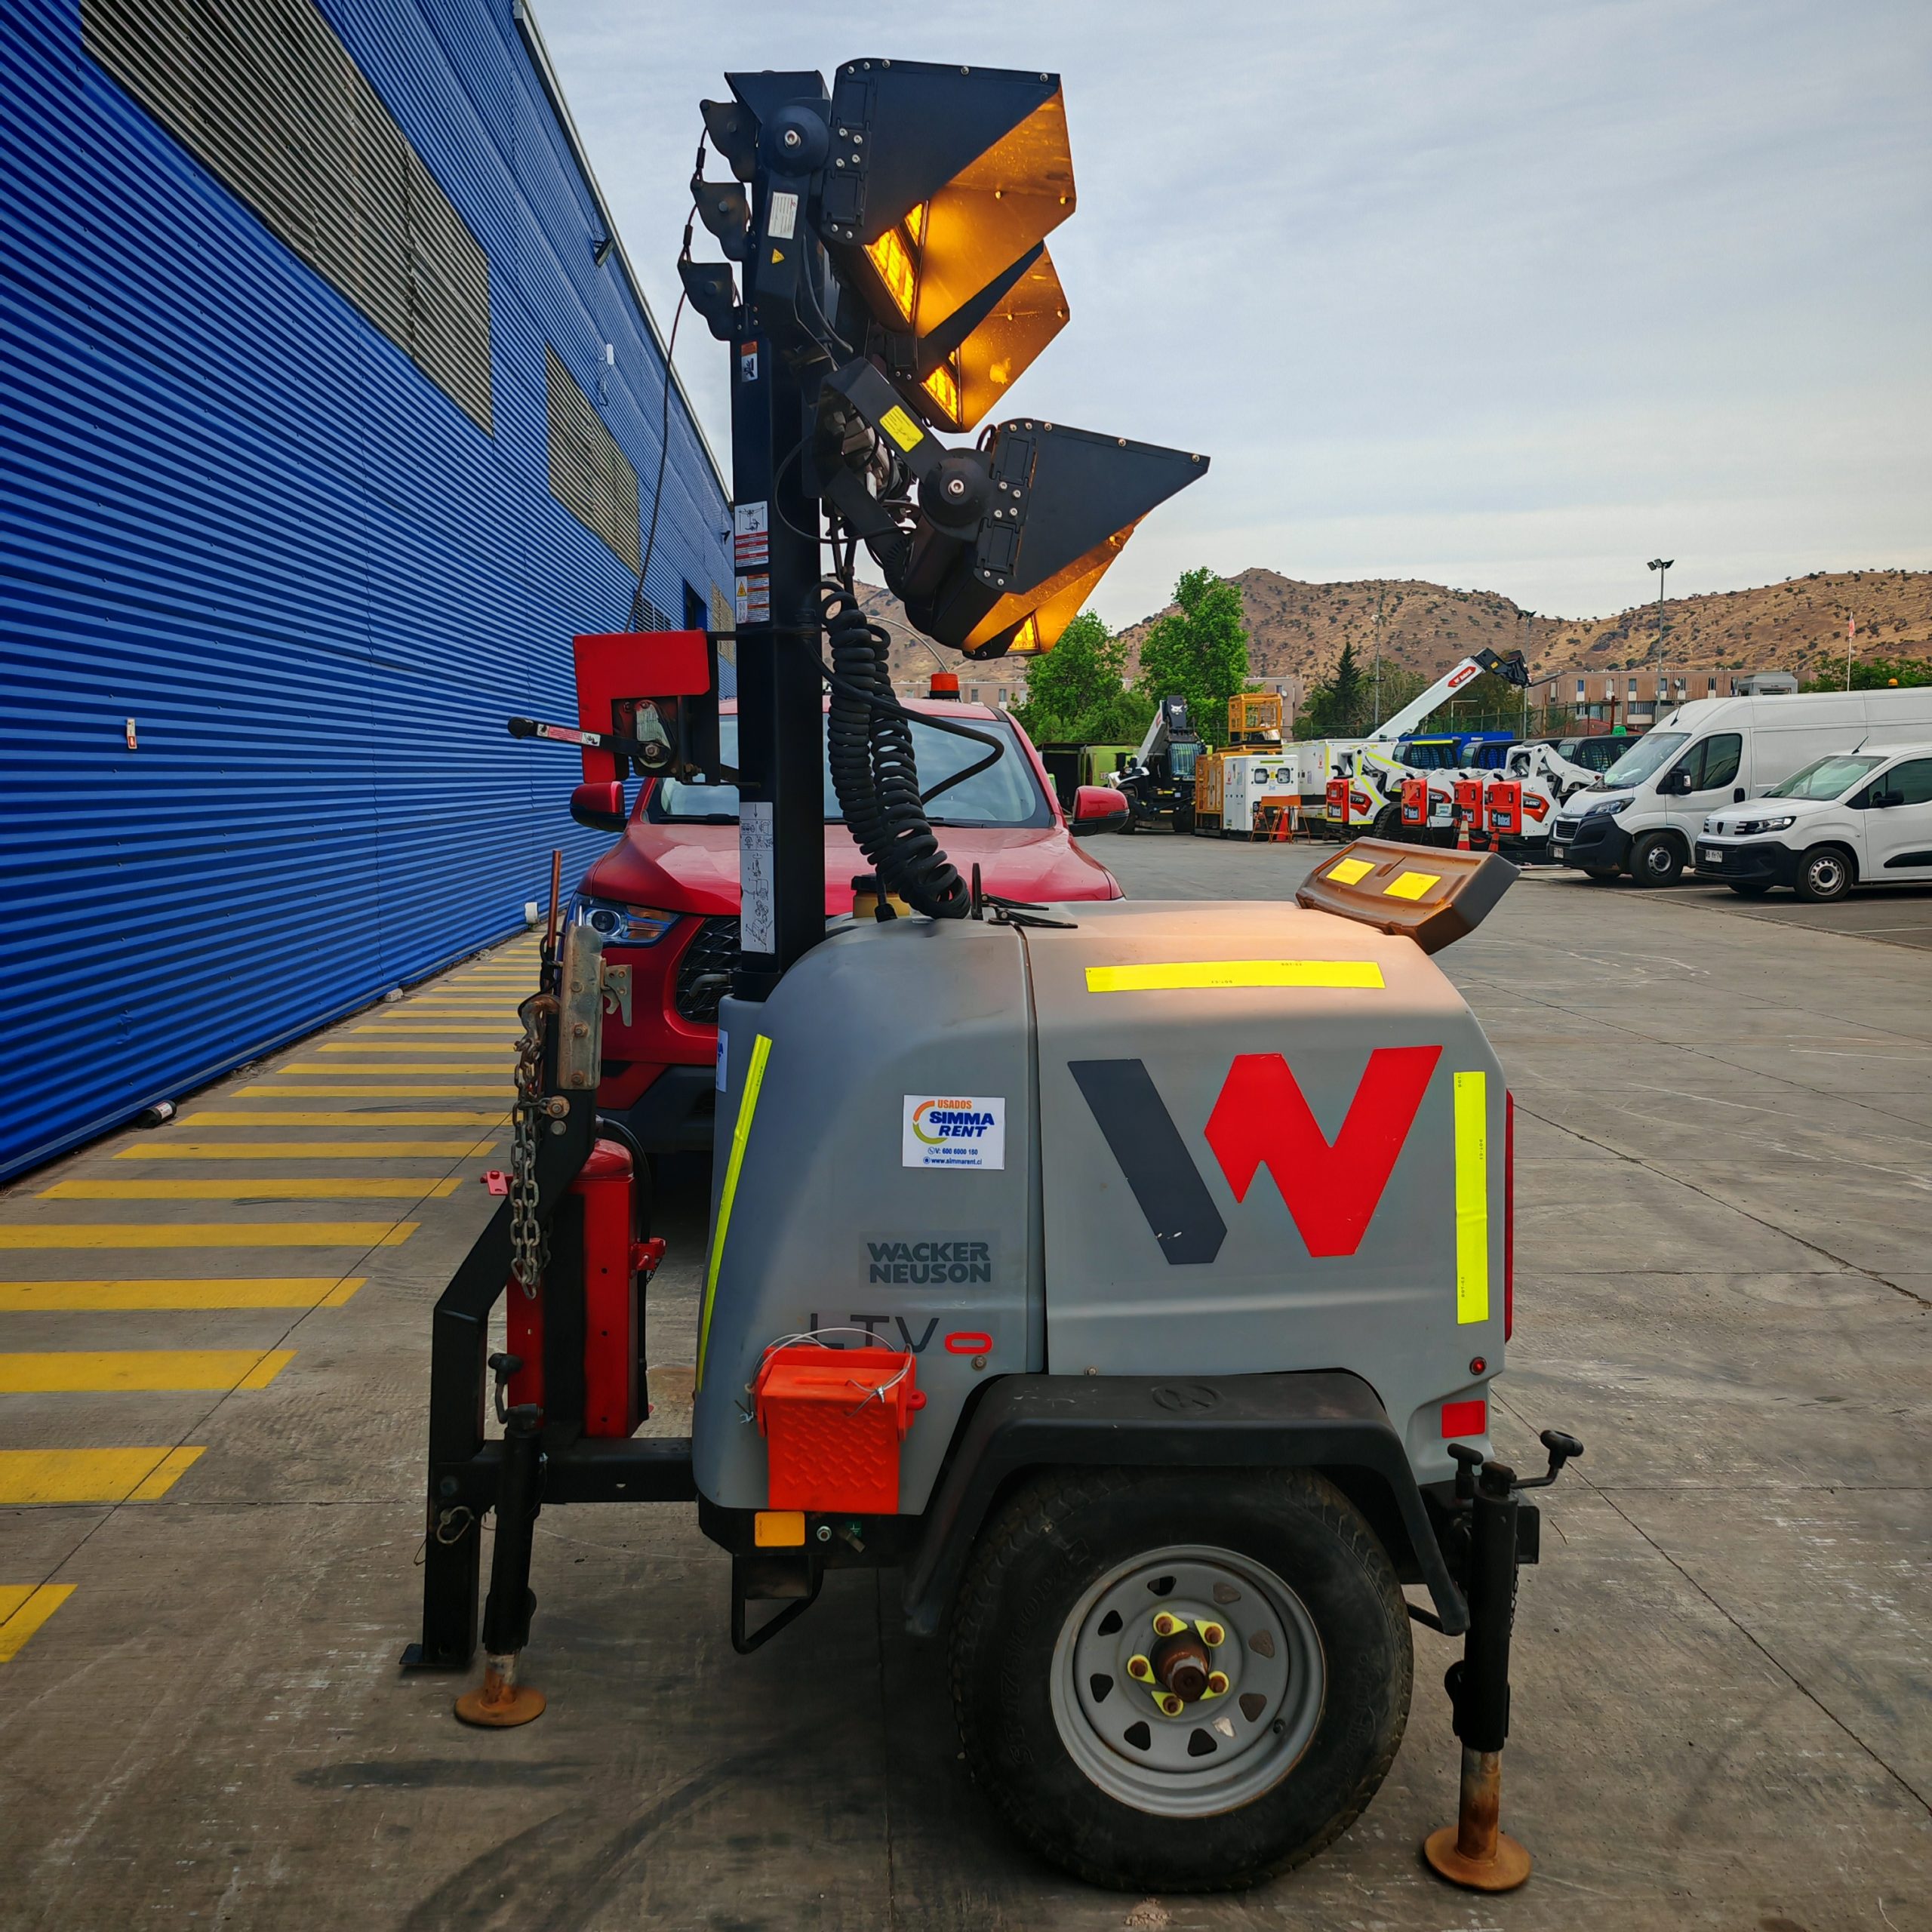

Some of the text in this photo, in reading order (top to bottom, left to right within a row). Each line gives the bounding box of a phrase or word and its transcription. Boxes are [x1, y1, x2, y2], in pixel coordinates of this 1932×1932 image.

[937, 1100, 972, 1109] USADOS
[929, 1111, 995, 1125] SIMMA
[938, 1125, 988, 1137] RENT
[867, 1242, 990, 1263] WACKER
[869, 1263, 991, 1284] NEUSON
